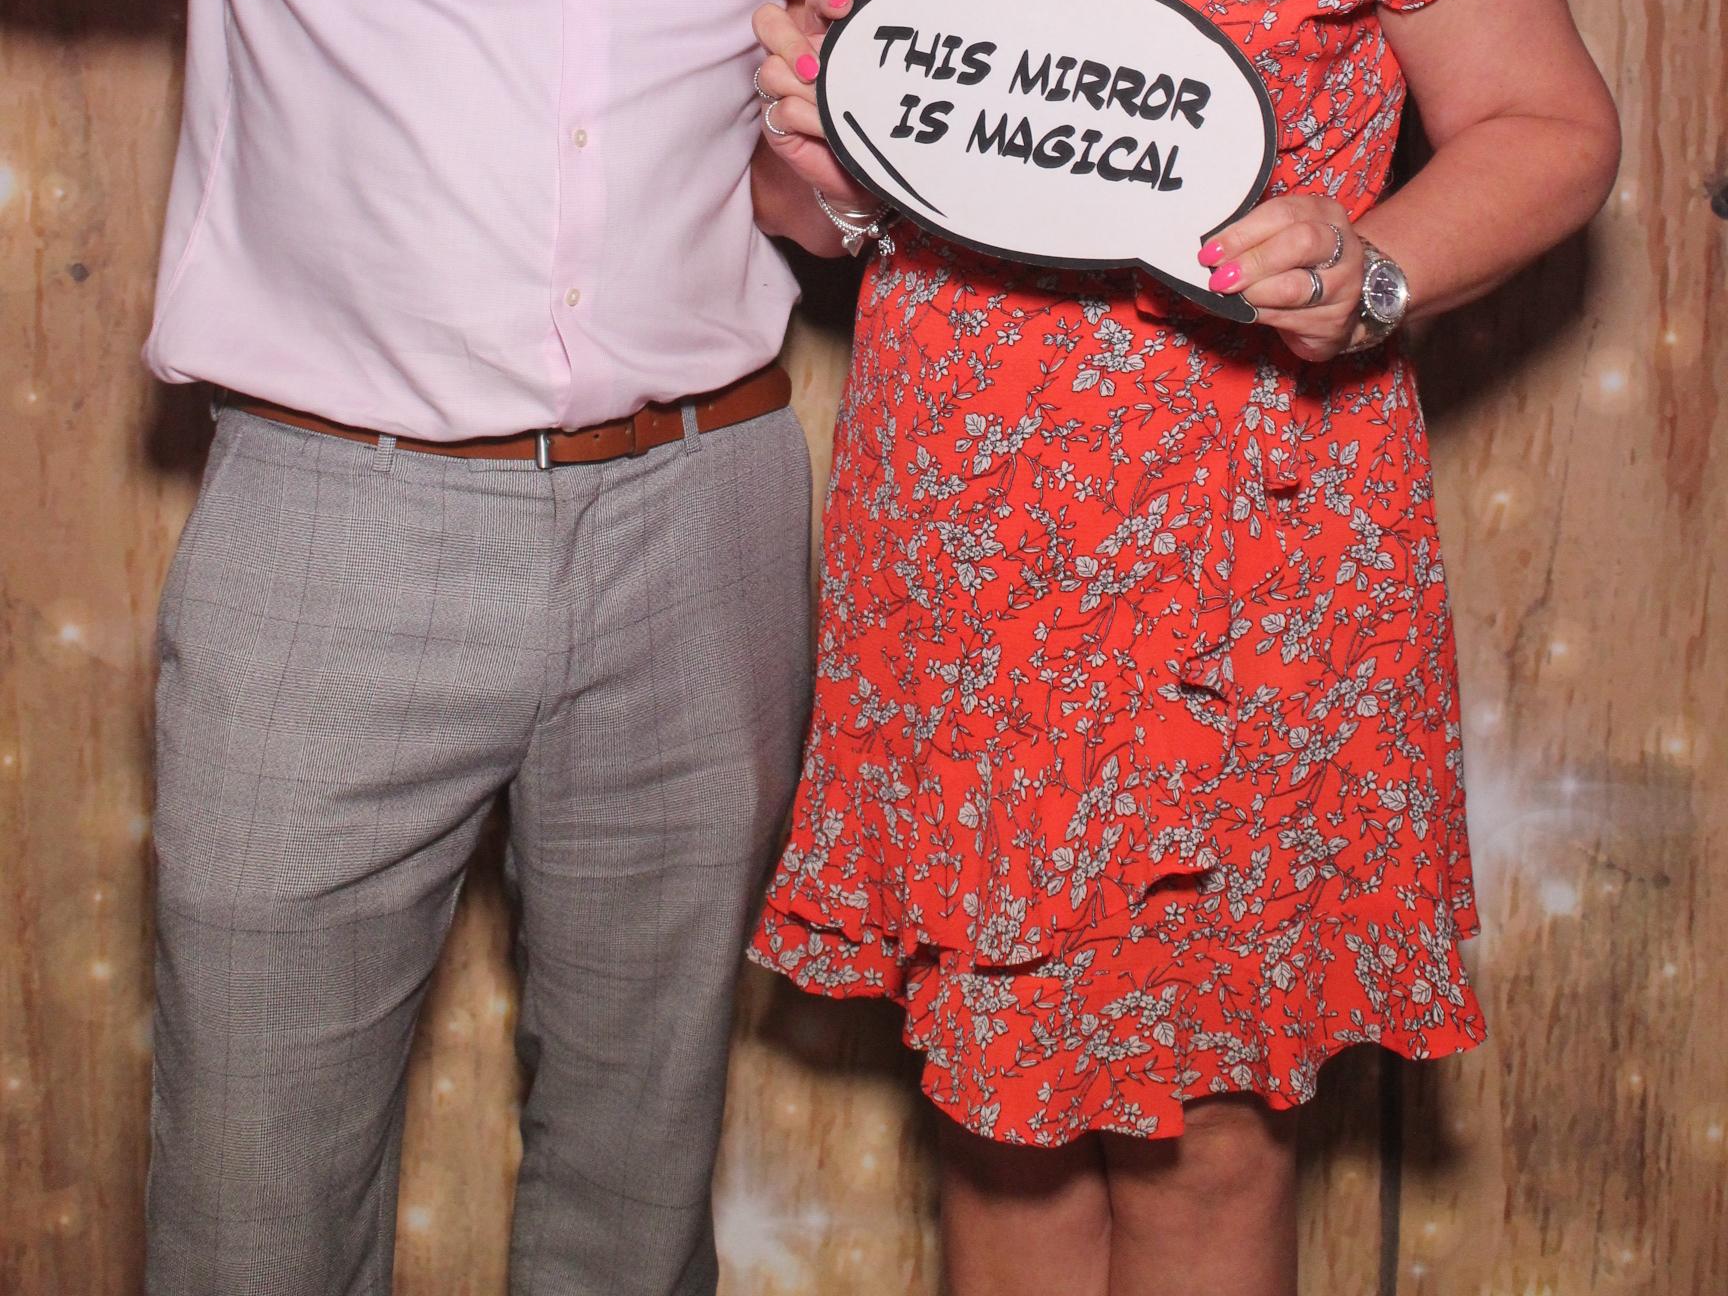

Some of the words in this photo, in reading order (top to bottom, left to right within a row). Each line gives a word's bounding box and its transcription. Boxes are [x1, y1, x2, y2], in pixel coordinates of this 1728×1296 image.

[873, 25, 997, 86] THIS
[1008, 49, 1211, 129] MIRROR
[890, 94, 954, 144] IS
[965, 109, 1184, 192] MAGICAL
